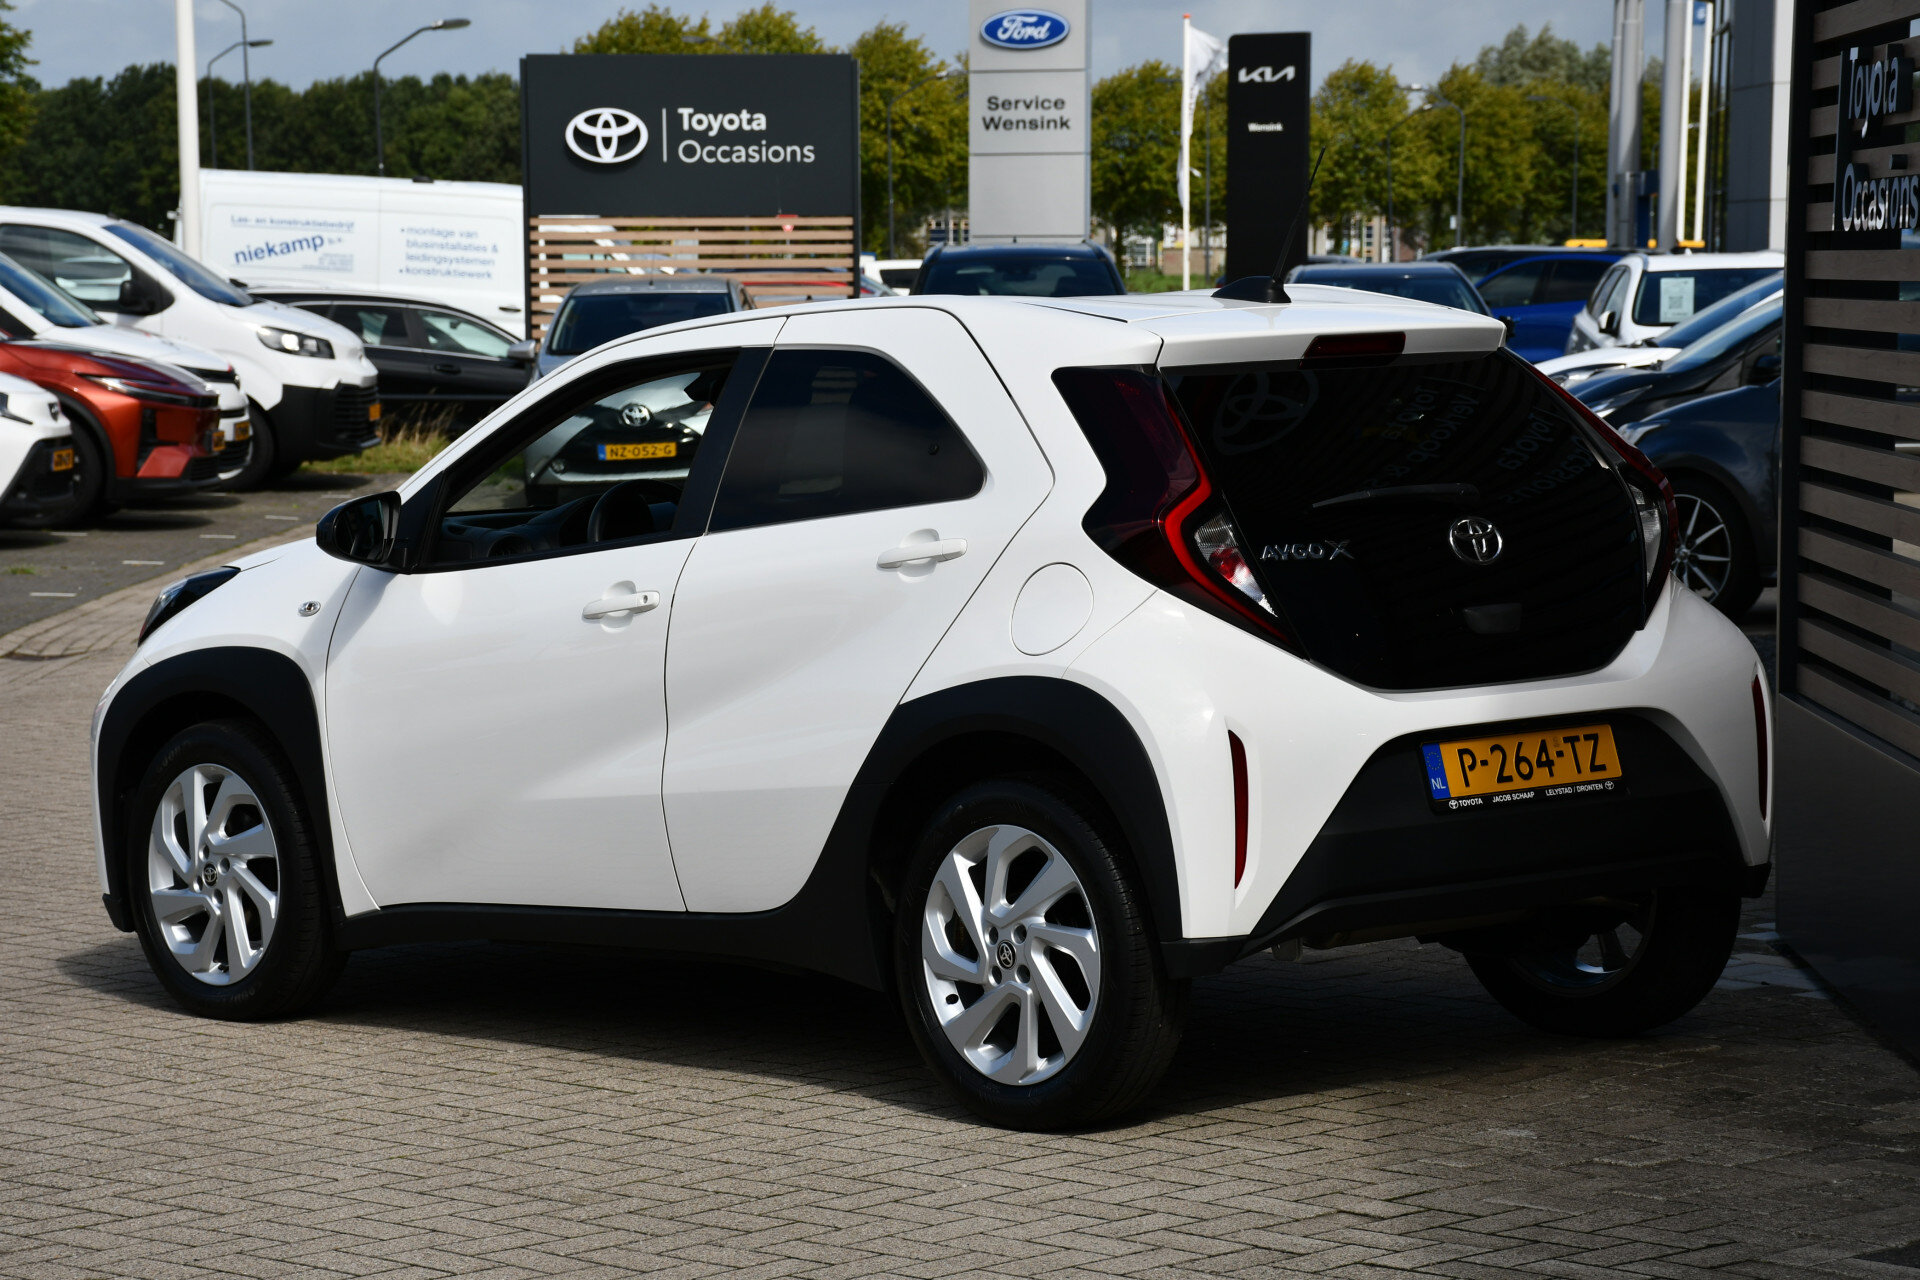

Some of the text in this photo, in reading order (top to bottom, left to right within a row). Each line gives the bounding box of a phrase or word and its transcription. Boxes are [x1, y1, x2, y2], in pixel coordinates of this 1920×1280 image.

[996, 15, 1052, 41] Ford
[1238, 65, 1296, 83] KIA
[986, 95, 1066, 111] Service
[1848, 46, 1899, 139] Toyota
[677, 107, 767, 137] Toyota
[982, 115, 1071, 131] Wensink
[678, 139, 816, 163] Occasions
[1842, 154, 1920, 232] Occasions
[234, 234, 325, 264] niekamp
[609, 445, 673, 458] NZ-052-G
[1260, 539, 1355, 560] AYGO X
[1456, 733, 1608, 788] P-264-TZ
[1431, 778, 1447, 790] NL
[1459, 797, 1483, 808] TOYOTA
[1492, 794, 1512, 803] JACOB
[1511, 791, 1535, 801] SCHAAP
[1545, 786, 1573, 796] LELYSTAD
[1576, 783, 1604, 793] DRONTEN
